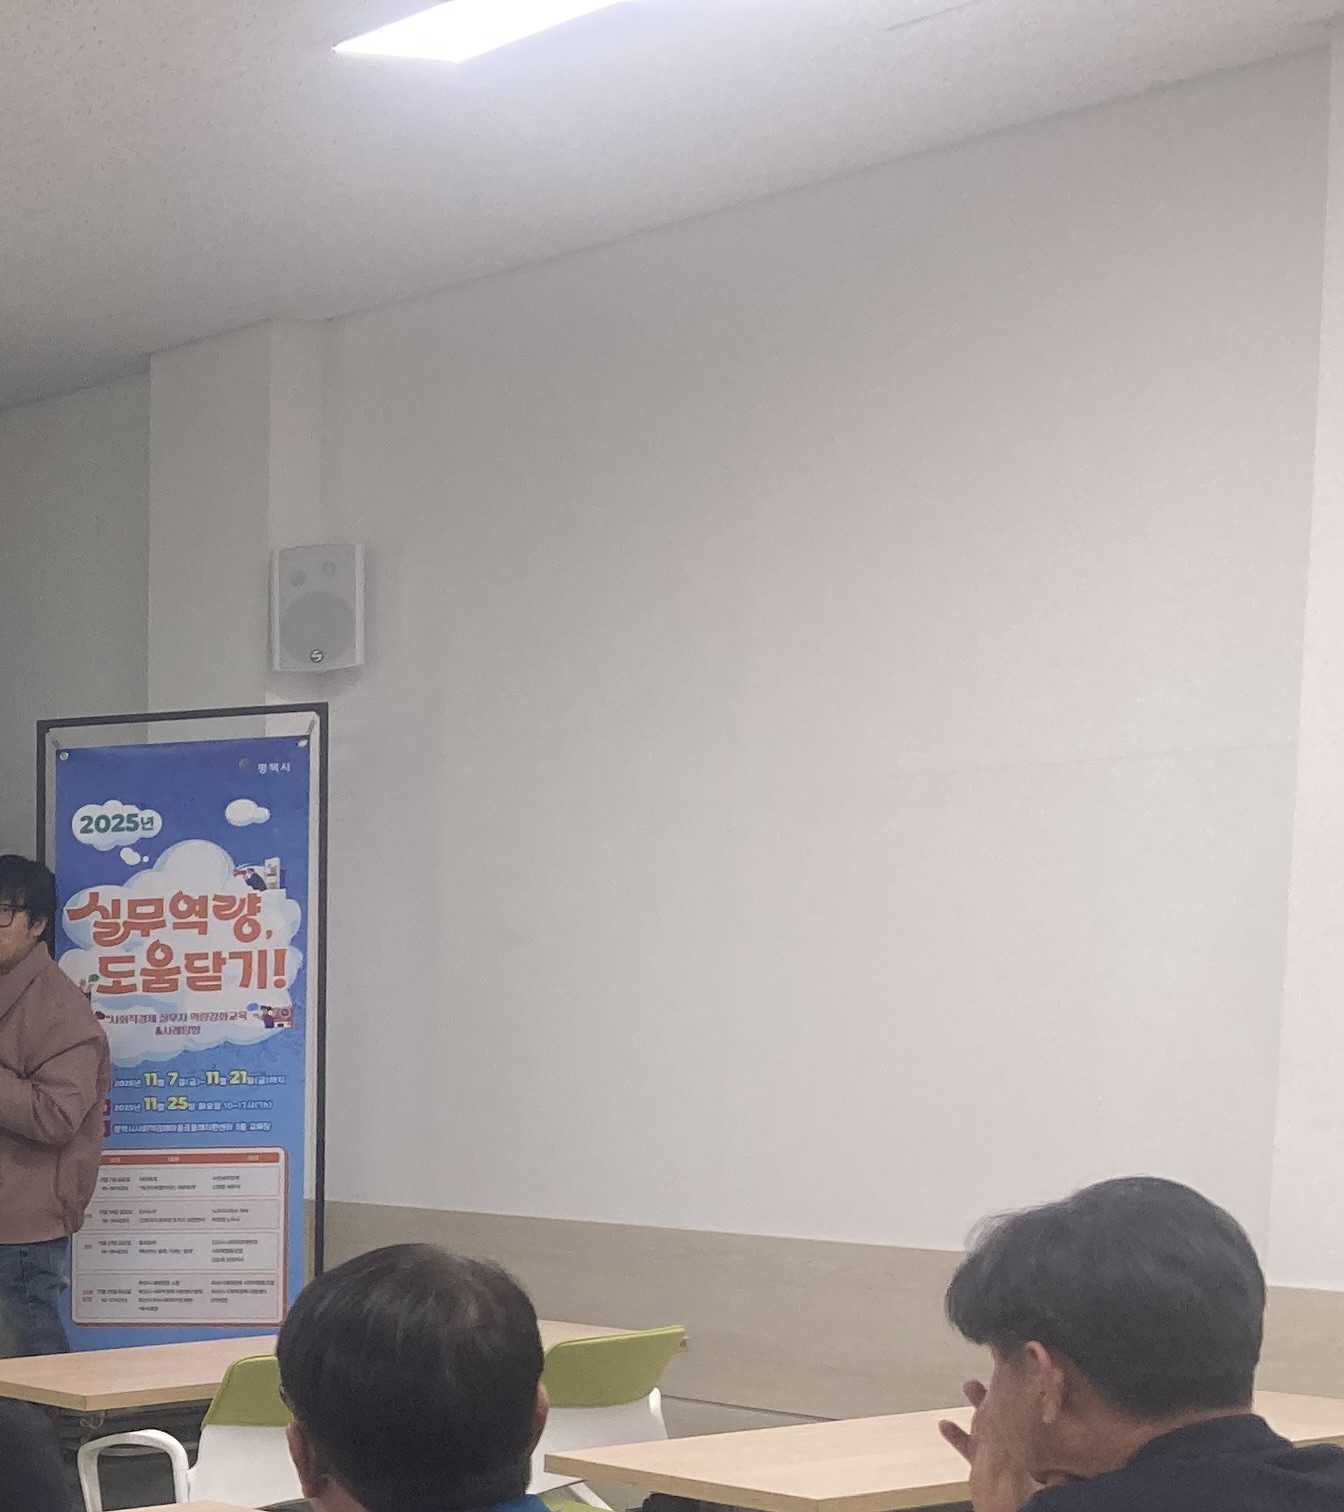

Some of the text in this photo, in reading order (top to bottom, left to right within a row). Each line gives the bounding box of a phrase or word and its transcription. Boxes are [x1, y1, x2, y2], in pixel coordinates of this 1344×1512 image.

[79, 813, 154, 834] 2025년
[66, 891, 273, 947] 실무역량,
[96, 939, 287, 994] 도움닫기!
